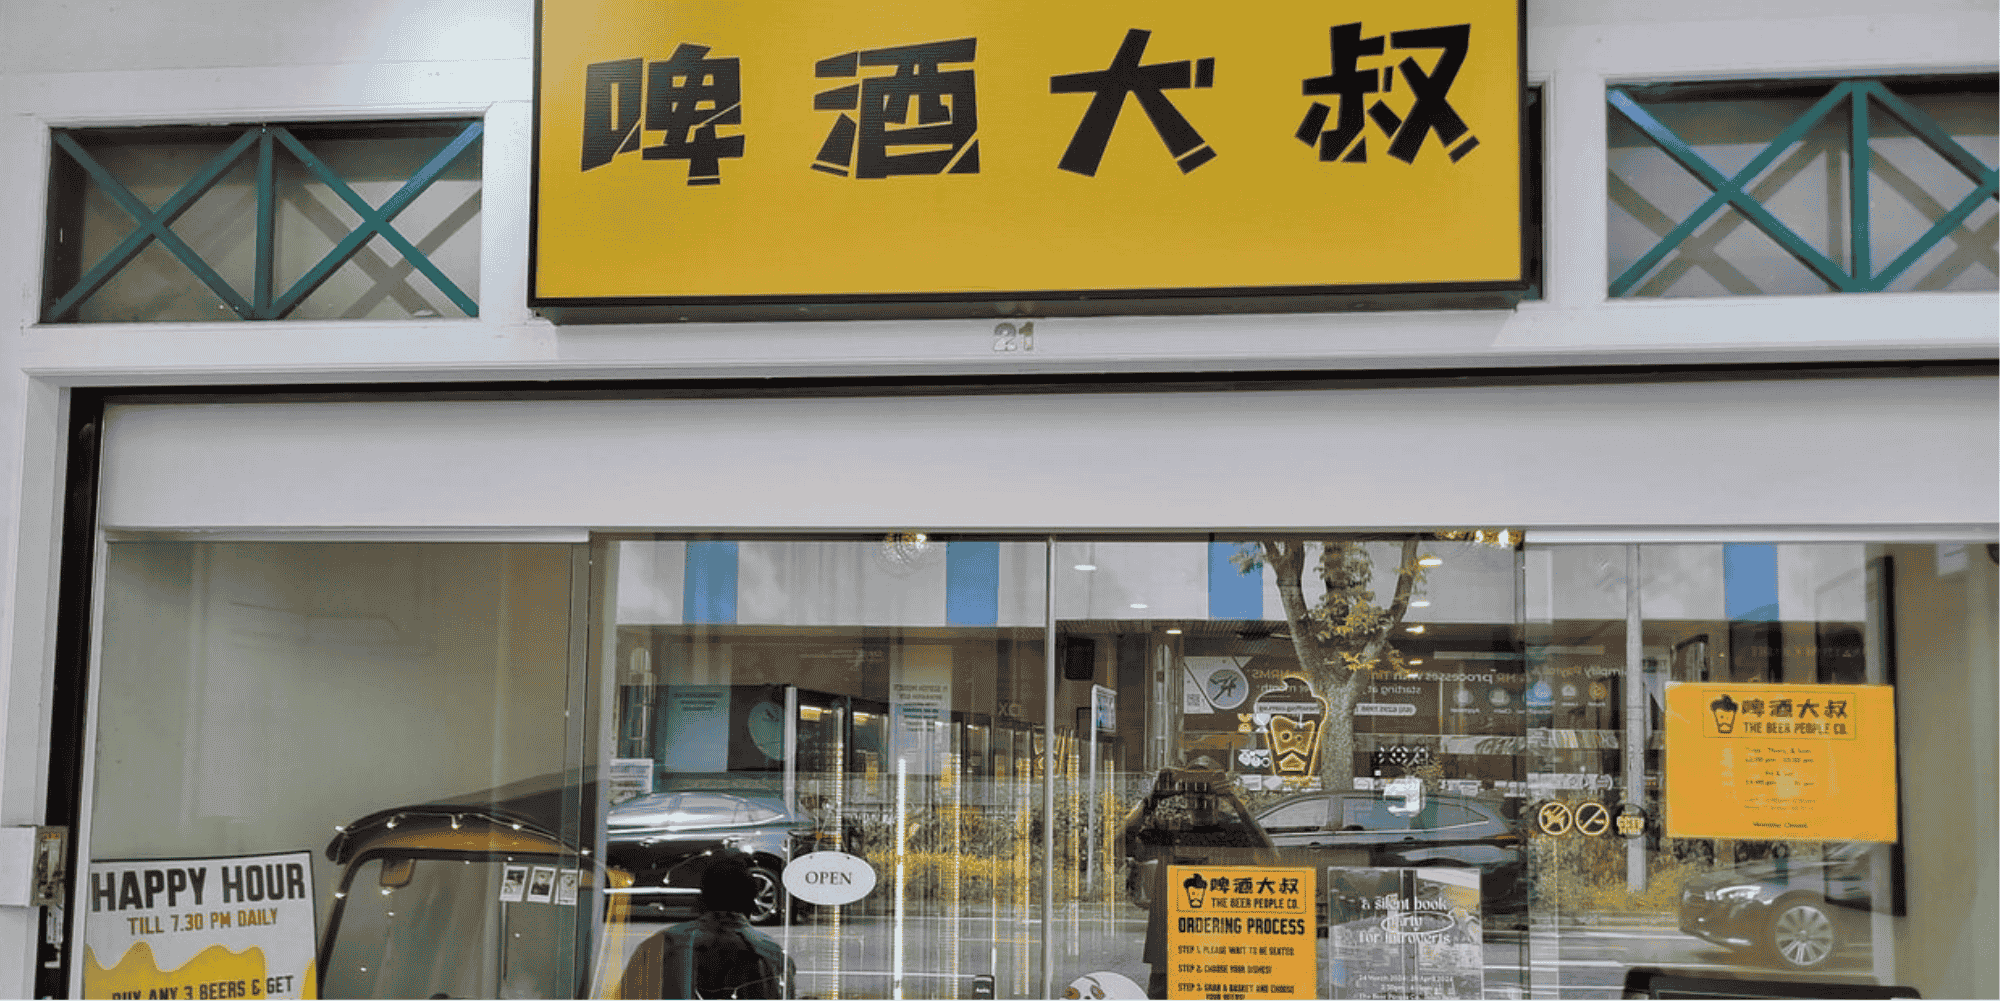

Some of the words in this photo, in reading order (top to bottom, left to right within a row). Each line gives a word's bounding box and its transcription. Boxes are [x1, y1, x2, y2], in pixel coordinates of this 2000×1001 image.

[581, 22, 1480, 186] 啤酒大叔
[994, 321, 1034, 351] 21
[1744, 722, 1762, 733] THE
[805, 871, 852, 885] OPEN
[1209, 877, 1299, 894] 啤酒大叔
[91, 867, 207, 912] HAPPY
[222, 863, 306, 903] HOUR
[1211, 897, 1227, 908] THE
[1230, 898, 1251, 908] BEER
[1254, 898, 1284, 909] PEOPLE
[1415, 896, 1447, 911] book
[127, 916, 165, 936] TILL
[171, 913, 204, 932] 7.30
[210, 911, 231, 929] PM
[238, 907, 278, 927] DAILY
[1178, 917, 1241, 933] ORDERING
[1247, 918, 1305, 935] PROCESS
[1178, 945, 1194, 954] STEP
[1178, 964, 1195, 973] STEP
[184, 985, 194, 1000] 3
[199, 980, 246, 1000] BEERS
[266, 975, 294, 994] GET
[1178, 983, 1195, 992] STEP
